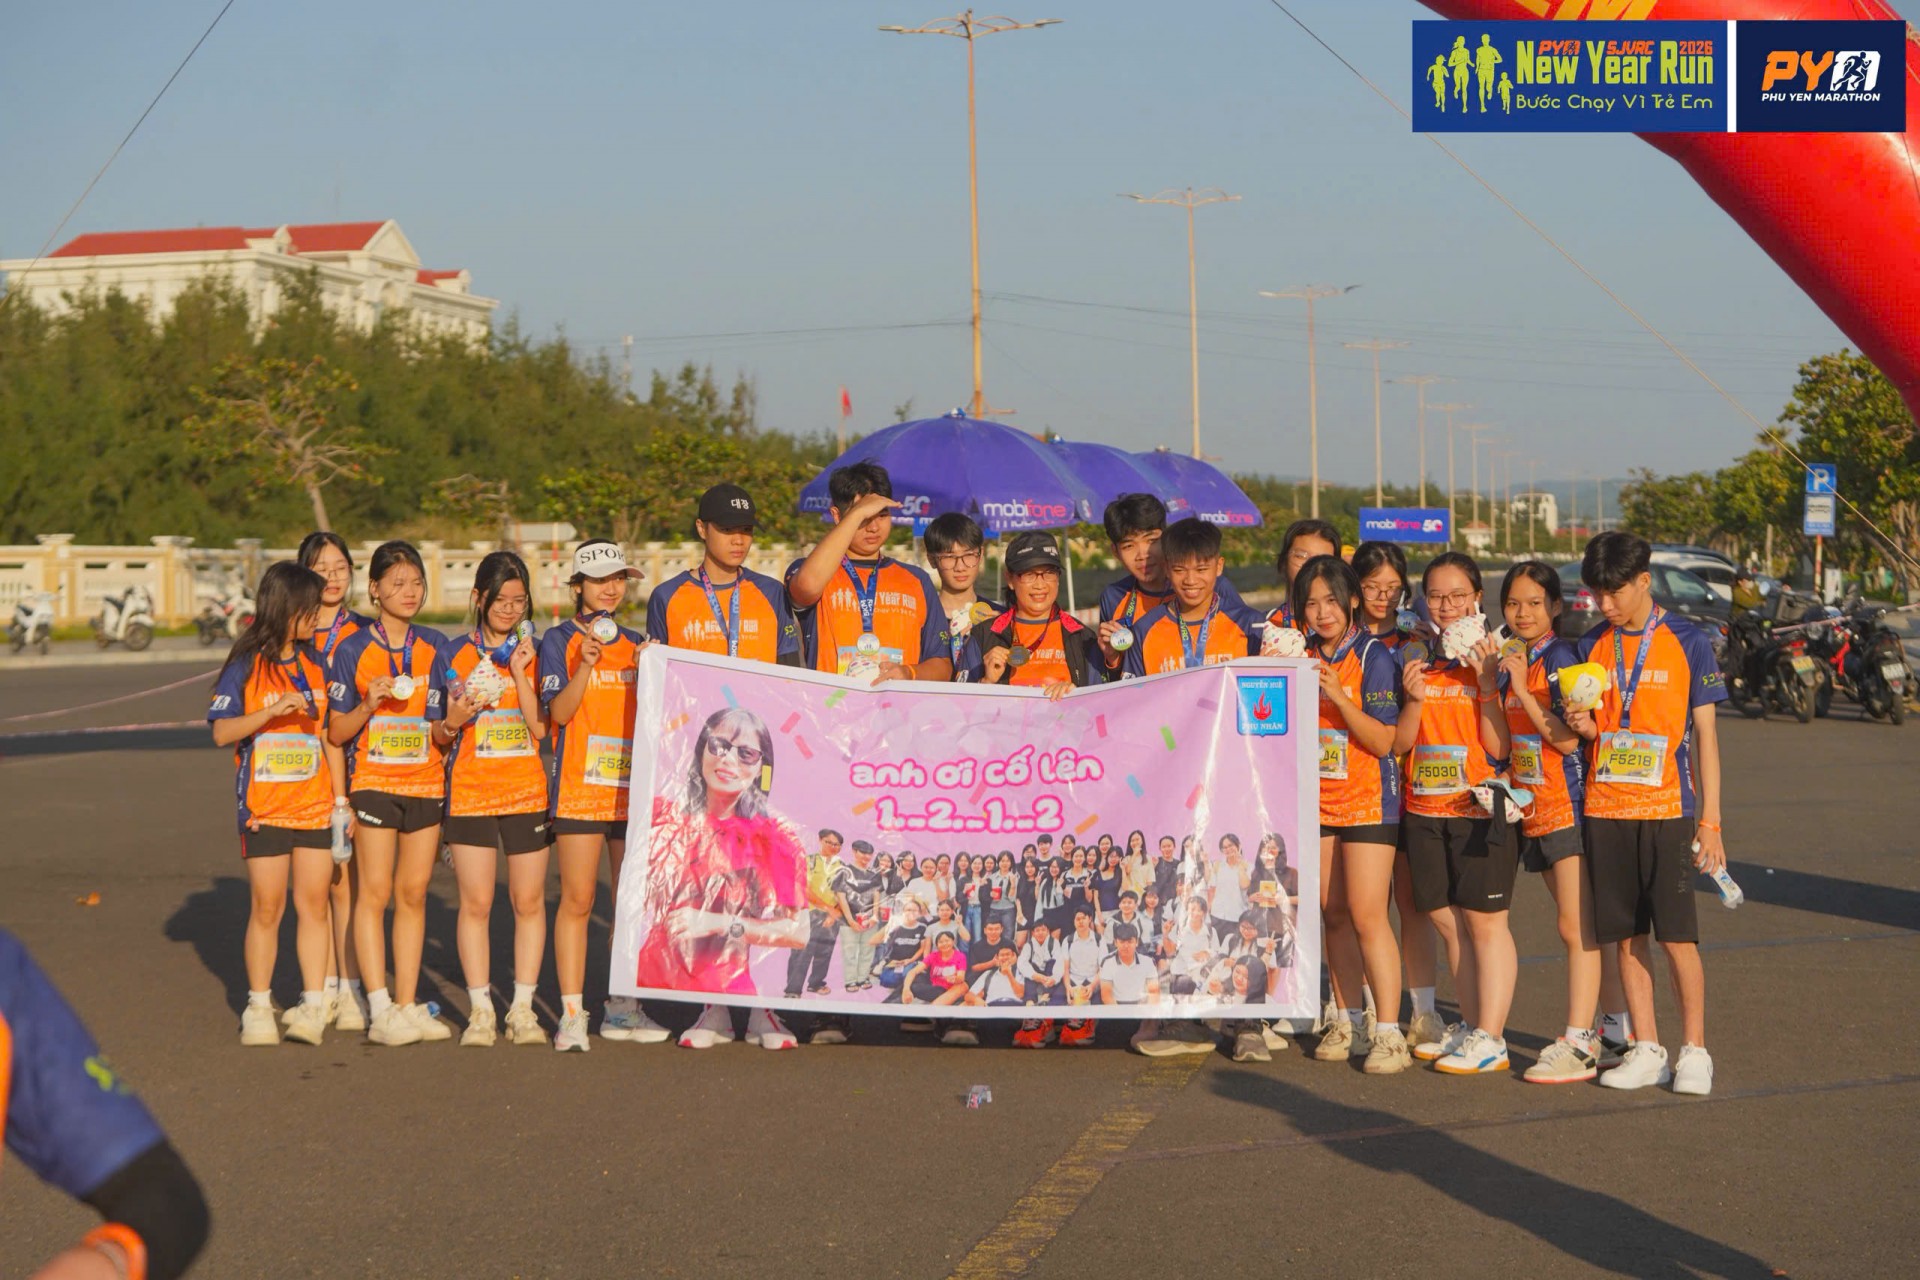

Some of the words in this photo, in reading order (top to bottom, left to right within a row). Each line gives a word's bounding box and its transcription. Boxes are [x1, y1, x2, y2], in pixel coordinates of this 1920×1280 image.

[983, 499, 1067, 517] mobifone
[1200, 510, 1254, 524] mobifone
[1365, 518, 1422, 530] mobifone
[487, 728, 528, 741] F5223
[381, 736, 421, 748] F5150
[266, 753, 313, 765] F5037
[1609, 754, 1652, 767] F5218
[850, 758, 928, 788] anh
[982, 744, 1035, 788] cố
[1418, 766, 1458, 777] F5030
